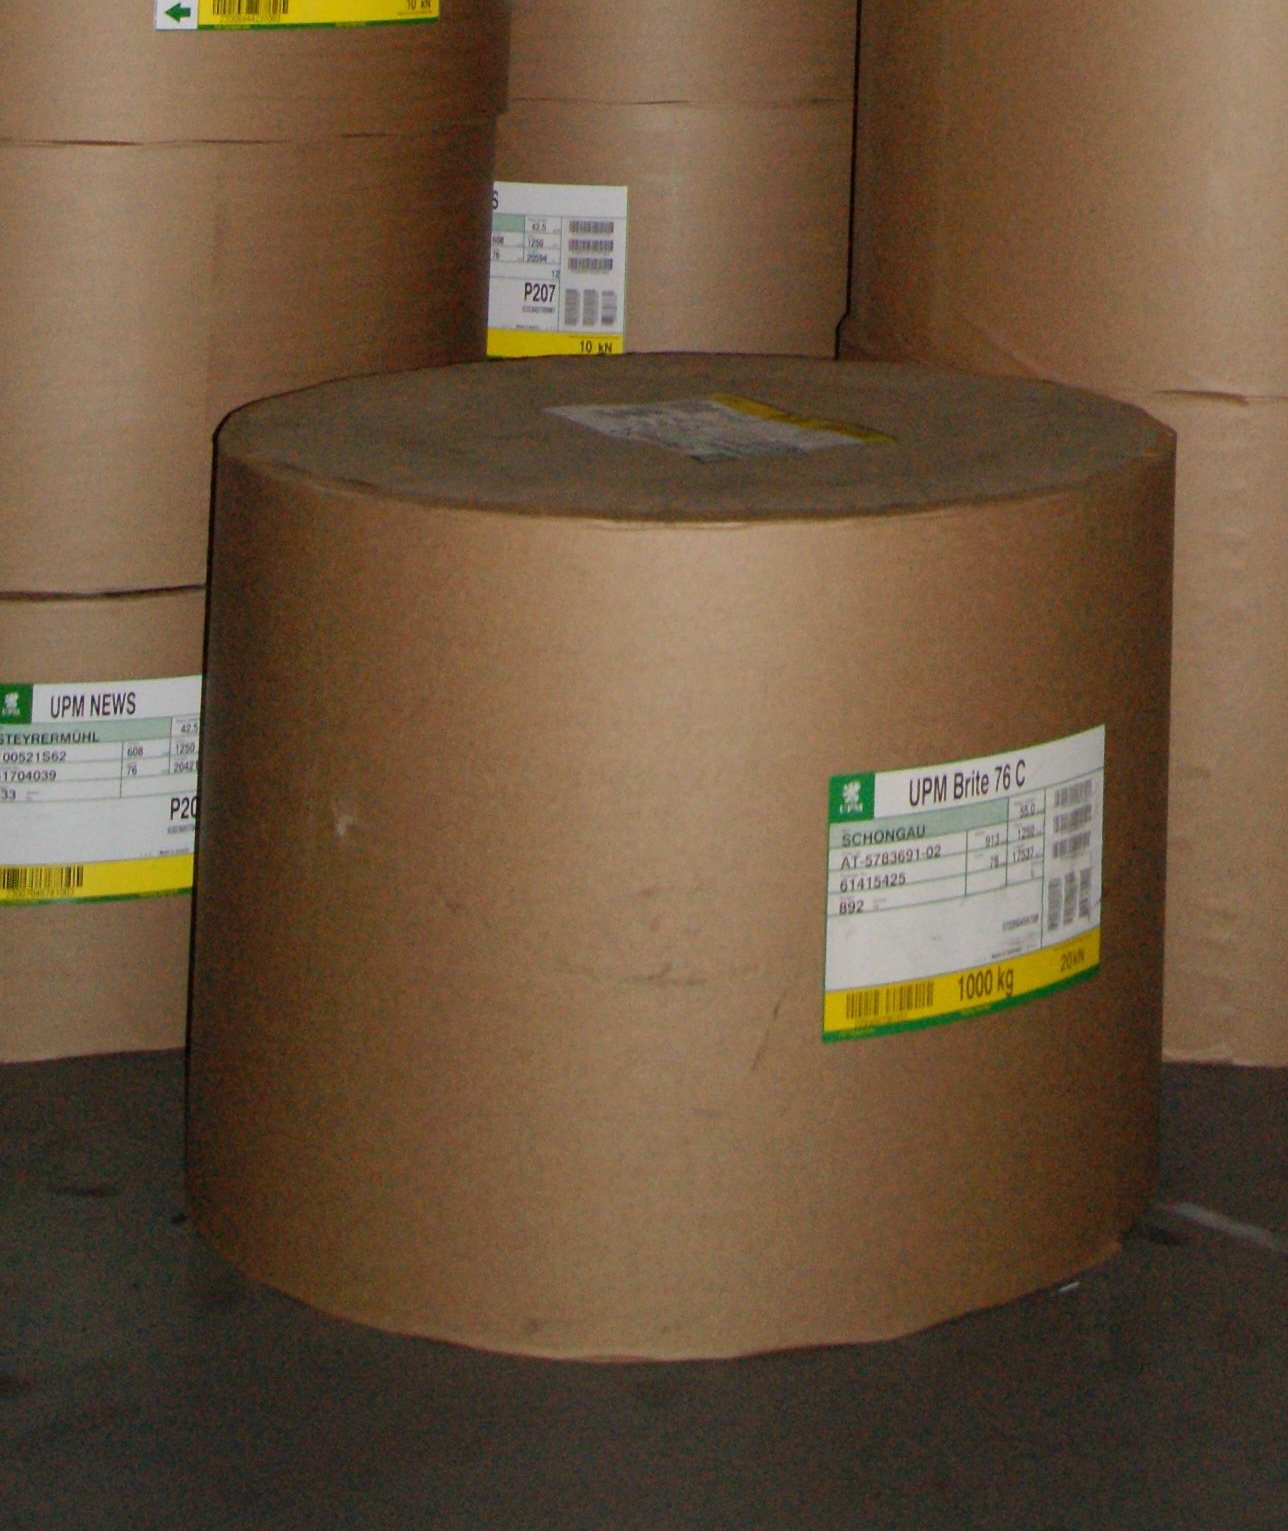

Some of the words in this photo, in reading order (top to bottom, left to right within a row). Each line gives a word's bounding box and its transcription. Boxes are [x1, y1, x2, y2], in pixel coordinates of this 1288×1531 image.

[524, 283, 556, 302] P207
[50, 695, 84, 718] UPM
[90, 692, 136, 716] NEWS
[181, 723, 198, 733] 42.5
[175, 741, 195, 755] 1250
[909, 778, 946, 807] UPM
[953, 770, 988, 800] Brite
[994, 764, 1010, 790] 76
[1016, 760, 1025, 787] C
[842, 825, 925, 847] SCHONGAU
[840, 874, 905, 892] 61415425
[958, 972, 992, 1001] 1000
[997, 967, 1014, 997] kg
